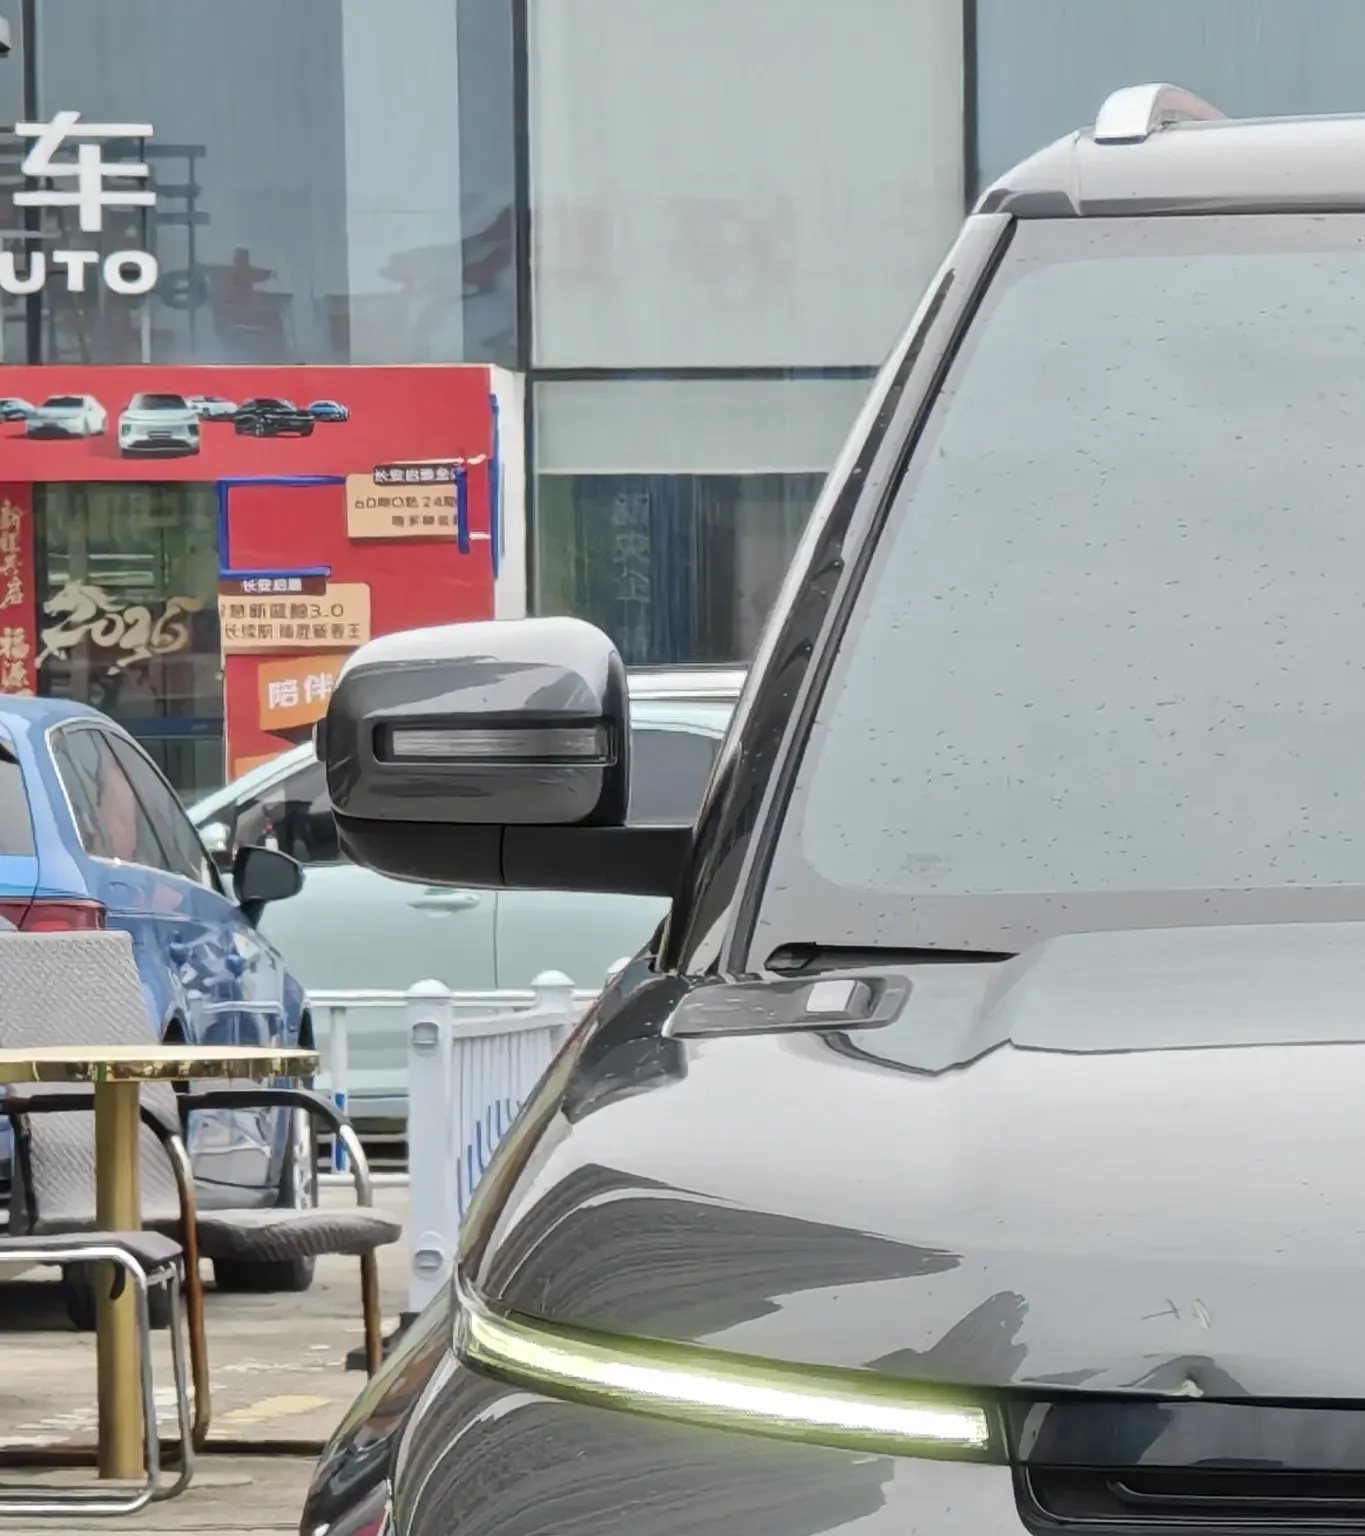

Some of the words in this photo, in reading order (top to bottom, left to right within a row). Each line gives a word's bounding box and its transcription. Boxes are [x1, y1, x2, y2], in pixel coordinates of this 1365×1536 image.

[13, 111, 156, 231] 车
[0, 250, 158, 294] UTO
[40, 584, 202, 666] 2026
